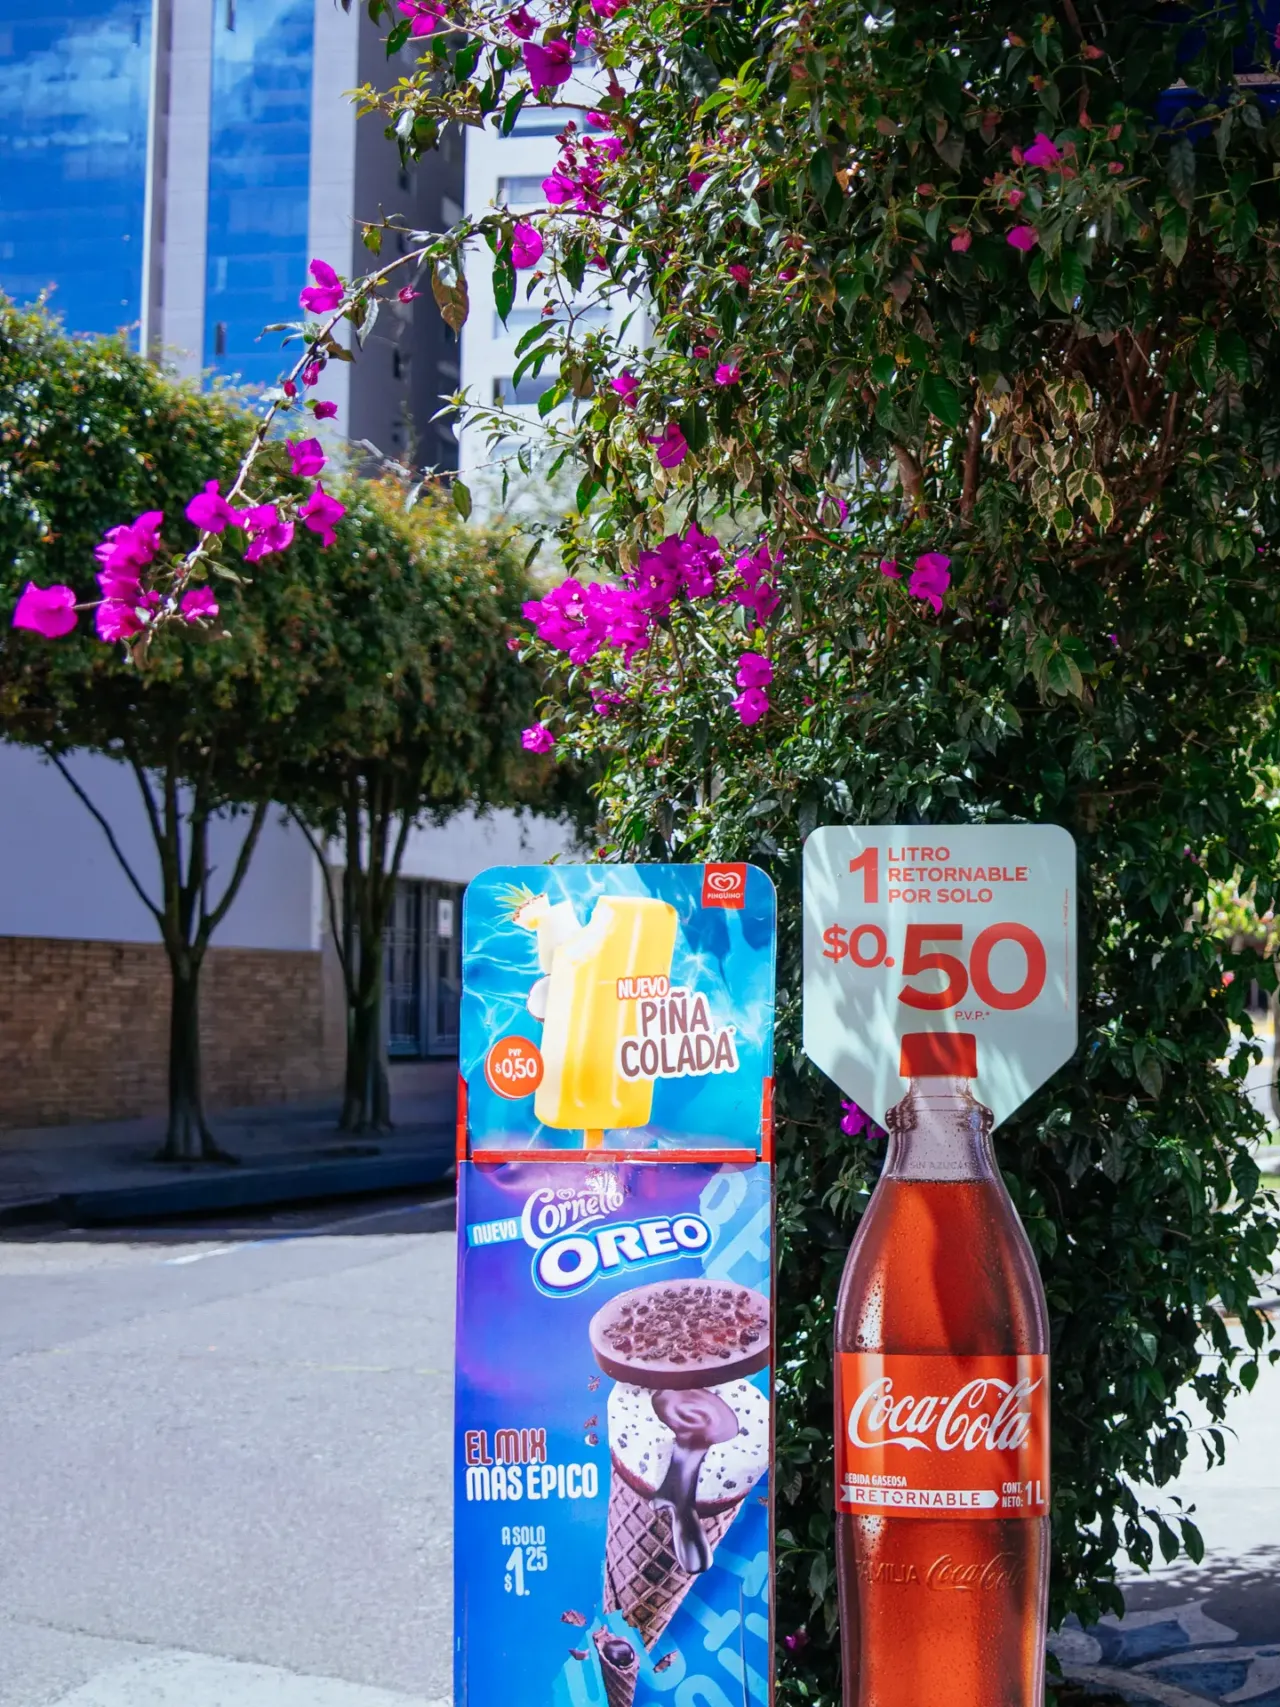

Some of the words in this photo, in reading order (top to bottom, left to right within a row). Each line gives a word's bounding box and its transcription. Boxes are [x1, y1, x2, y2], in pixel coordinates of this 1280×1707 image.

[849, 847, 879, 903] 1
[888, 847, 950, 862] LITRO
[888, 867, 1028, 882] RETORNABLE
[888, 888, 932, 903] POR
[937, 888, 993, 903] SOLO
[822, 921, 1047, 1011] $0.50
[617, 977, 669, 998] NUEVO
[641, 991, 710, 1037] PIÑA
[495, 1058, 538, 1082] $0,50
[472, 1220, 517, 1244] NUEVO
[521, 1178, 624, 1250] Cornetto
[537, 1218, 708, 1288] OREO
[848, 1376, 1044, 1452] Coca-Cola
[465, 1430, 493, 1465] EL
[495, 1428, 547, 1465] MIX
[466, 1458, 523, 1501] MÁS
[527, 1457, 598, 1500] ÉPICO
[872, 1474, 907, 1487] GASEOSA
[855, 1488, 981, 1506] RETORNABLE
[1002, 1482, 1023, 1494] CONT.
[1025, 1481, 1032, 1506] 1
[1036, 1480, 1045, 1505] L
[1002, 1496, 1024, 1508] NETO:
[502, 1527, 511, 1545] A
[512, 1526, 545, 1545] SOLO
